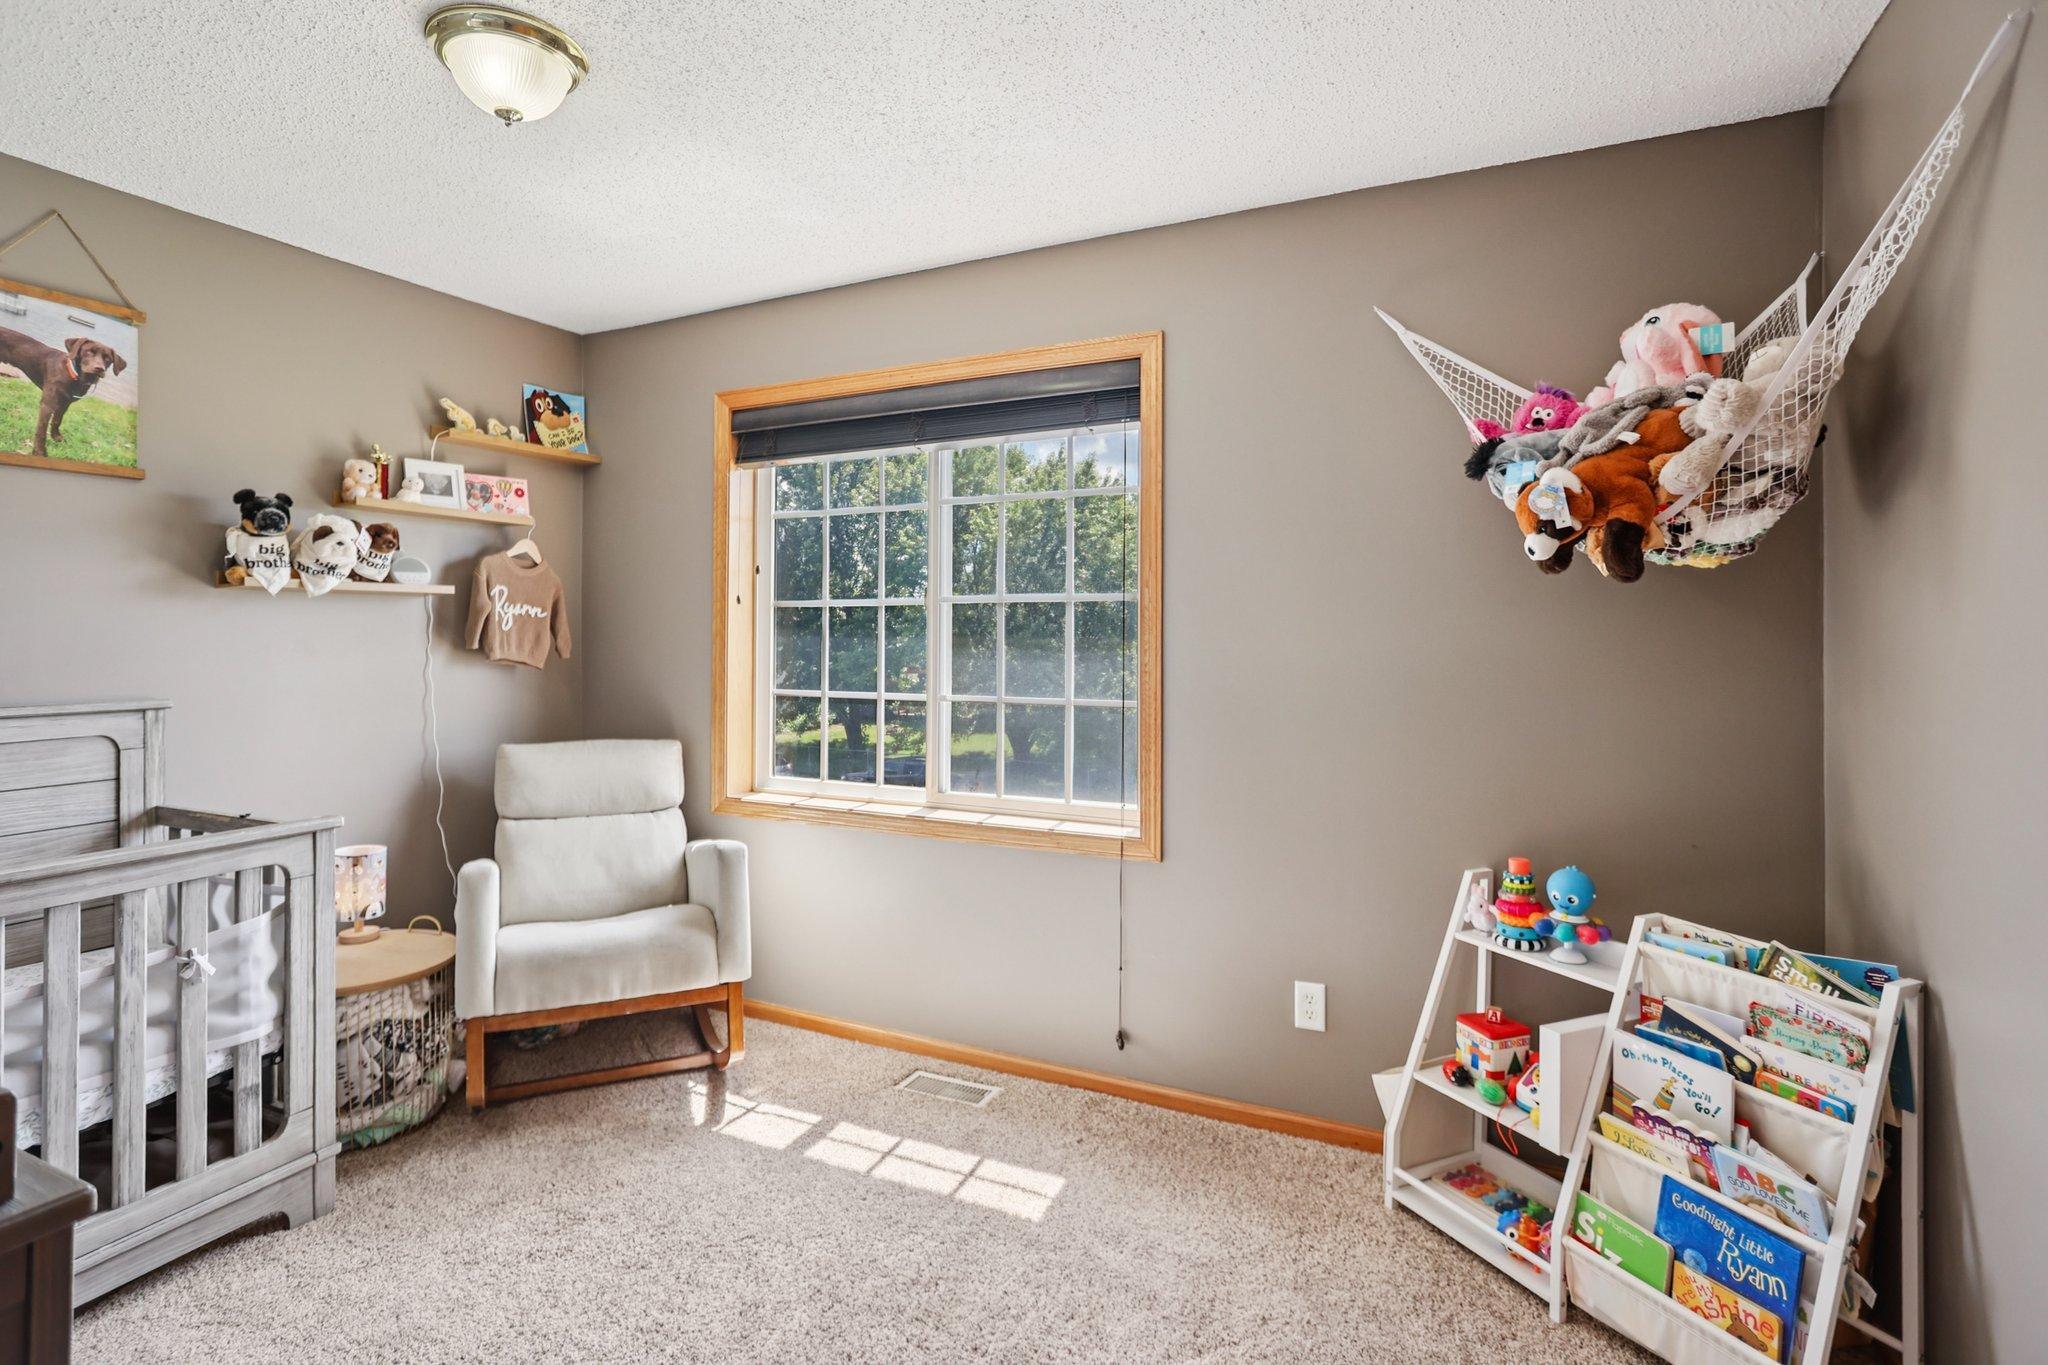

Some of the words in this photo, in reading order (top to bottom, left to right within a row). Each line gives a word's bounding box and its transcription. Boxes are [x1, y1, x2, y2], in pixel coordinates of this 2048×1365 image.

[568, 430, 583, 444] DOG?
[259, 543, 285, 557] big
[244, 558, 293, 569] broth
[490, 584, 548, 631] Ryann
[1774, 955, 1840, 999] Small
[1489, 1011, 1499, 1021] A
[1621, 1048, 1640, 1060] Oh,
[1642, 1051, 1658, 1064] the
[1660, 1056, 1694, 1086] Places
[1683, 1086, 1712, 1103] You'll
[1695, 1103, 1722, 1118] Go!
[1737, 1164, 1796, 1206] ABC
[1727, 1175, 1751, 1191] GOD
[1754, 1187, 1788, 1210] LOVES
[1792, 1206, 1810, 1221] ME
[1672, 1192, 1736, 1240] Goodnight
[1739, 1233, 1775, 1264] Little
[1717, 1238, 1788, 1301] Ryann
[1677, 1274, 1697, 1286] You
[1676, 1289, 1696, 1305] Are
[1696, 1284, 1714, 1299] My
[1691, 1294, 1775, 1341] nshine
